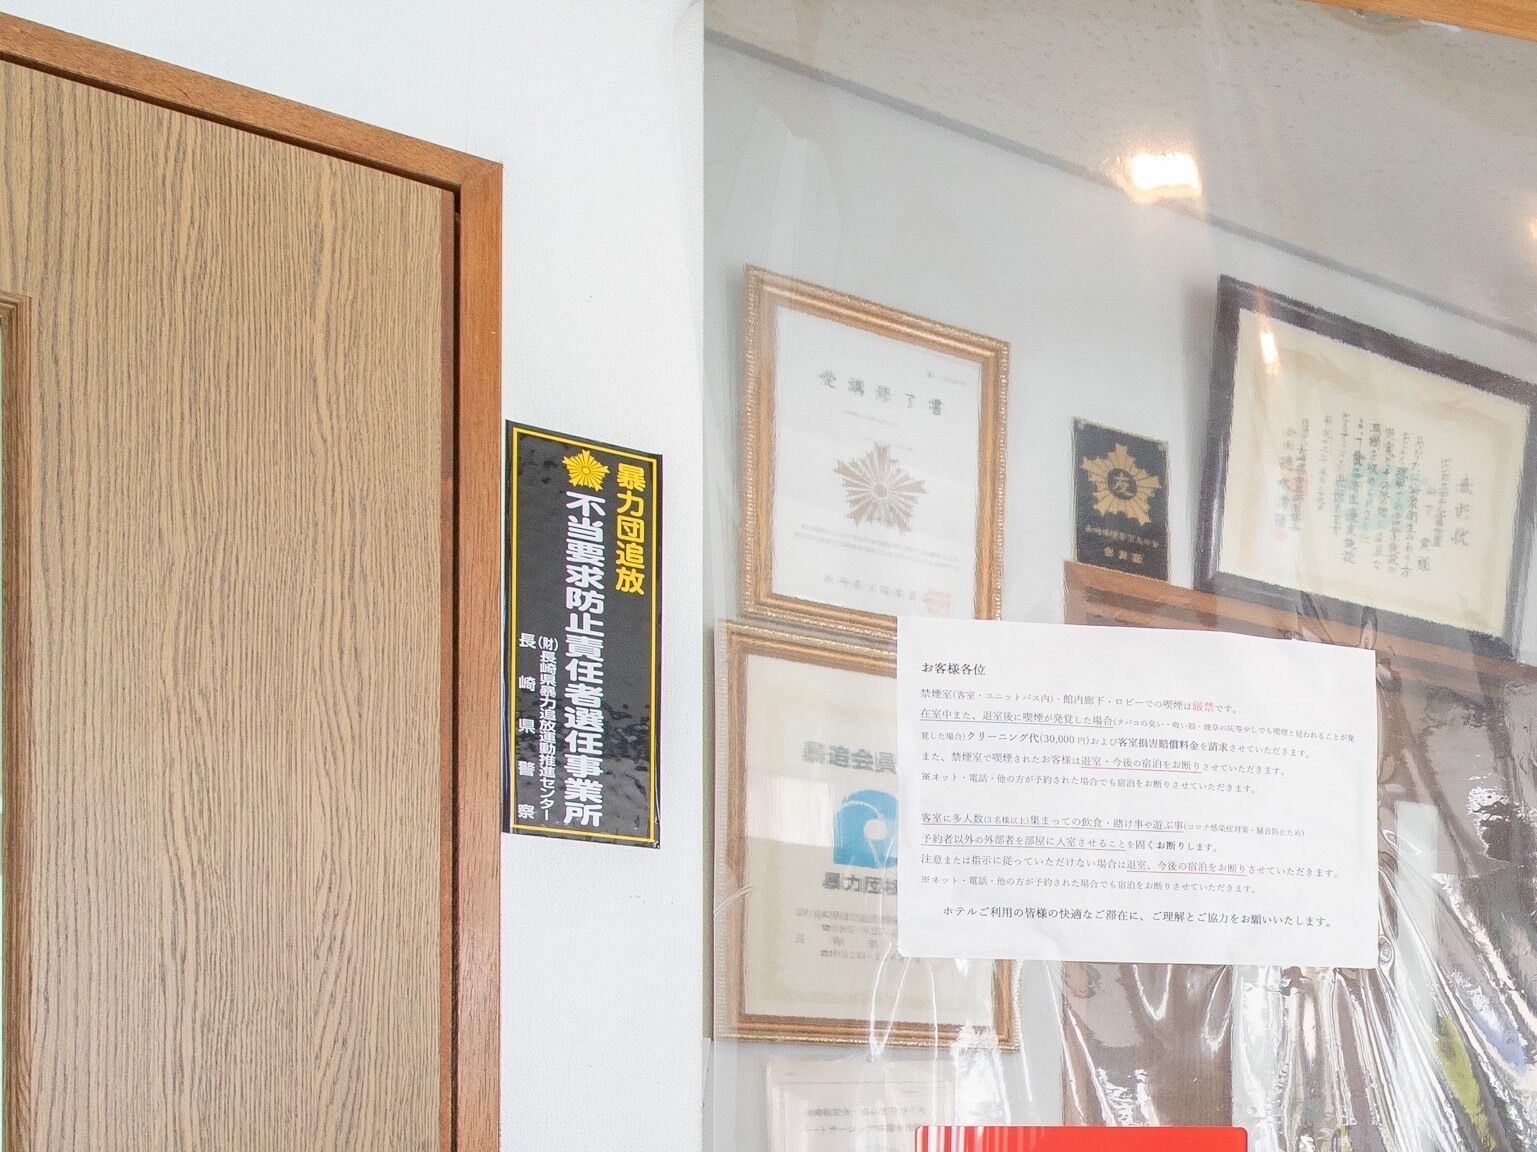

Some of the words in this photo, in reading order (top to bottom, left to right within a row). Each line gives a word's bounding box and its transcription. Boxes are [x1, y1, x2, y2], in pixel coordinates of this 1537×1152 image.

[616, 464, 645, 595] 暴力団追放
[517, 633, 537, 820] 長崎県警察
[563, 490, 605, 828] 不当要求防止責任者選任事業所
[921, 662, 986, 676] お客様各位
